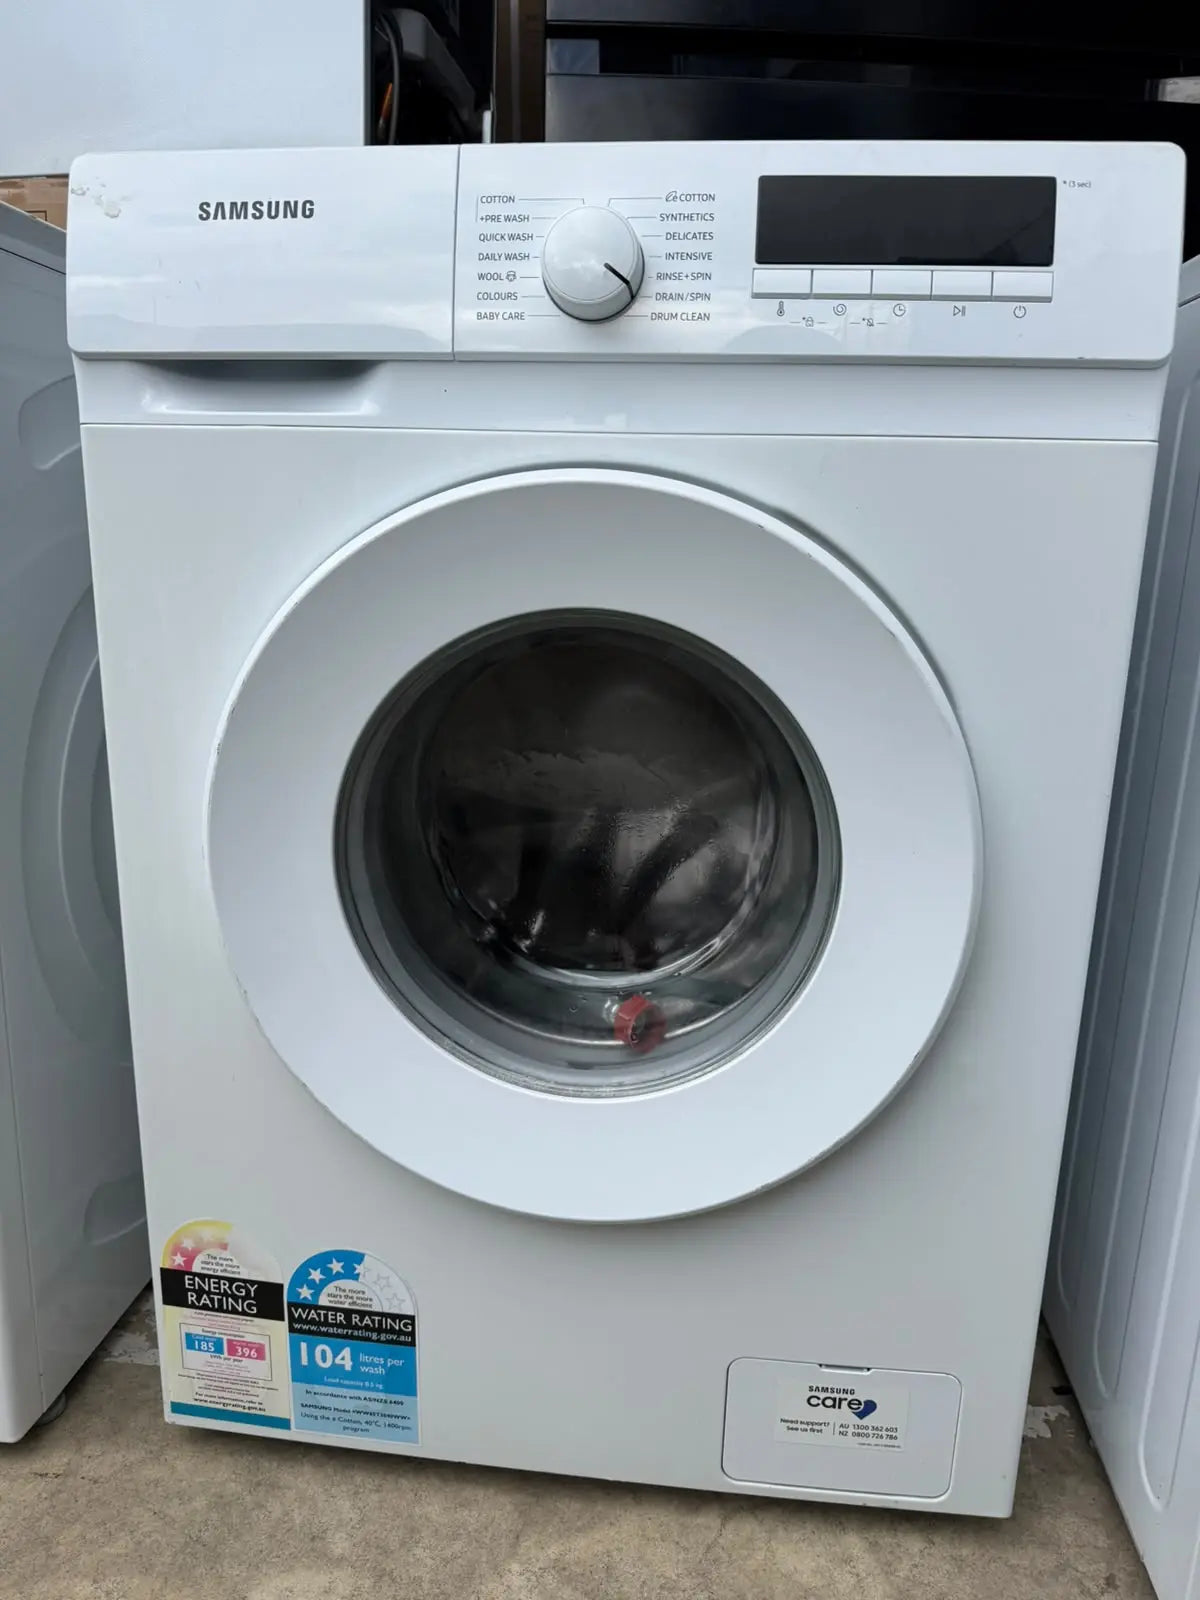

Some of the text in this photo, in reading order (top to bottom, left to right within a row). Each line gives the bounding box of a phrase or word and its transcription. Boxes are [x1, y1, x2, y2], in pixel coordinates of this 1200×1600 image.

[480, 195, 515, 204] COTTON
[198, 199, 315, 221] SAMSUNG
[479, 214, 530, 223] +PRE WASH
[659, 213, 715, 222] SYNTHETICS
[478, 233, 534, 243] QUICK WASH
[665, 232, 714, 241] DELICATES
[478, 252, 530, 262] DAILY WASH
[665, 252, 713, 261] INTENSIVE
[477, 272, 504, 281] WOOL
[656, 272, 712, 281] RINSE+SPIN
[476, 291, 518, 301] COLOURS
[655, 292, 711, 301] DRAIN/SPIN
[476, 311, 526, 321] BABY CARE
[650, 312, 711, 321] DRUM CLEAN
[200, 1265, 241, 1276] energy efficient
[184, 1274, 259, 1298] ENERGY
[333, 1285, 346, 1293] The
[327, 1291, 342, 1300] stars
[355, 1295, 374, 1303] more
[187, 1291, 258, 1314] RATING
[347, 1300, 374, 1309] efficient
[291, 1306, 413, 1332] WATER RATING
[292, 1322, 412, 1342] www.waterrating.gov.au
[194, 1339, 216, 1352] 185
[235, 1346, 258, 1359] 396
[299, 1341, 353, 1371] 104
[359, 1352, 405, 1367] litres per
[359, 1365, 386, 1375] wash
[808, 1385, 856, 1396] SAMSUNG
[300, 1402, 333, 1411] SAMSUNG
[806, 1394, 863, 1411] care
[300, 1411, 319, 1421] Using
[780, 1417, 830, 1427] Need support?
[342, 1425, 370, 1433] program
[852, 1423, 870, 1431] 1300
[870, 1425, 884, 1433] 362
[885, 1426, 898, 1434] 603
[851, 1431, 870, 1439] 0800
[871, 1432, 884, 1440] 726
[885, 1433, 898, 1441] 786
